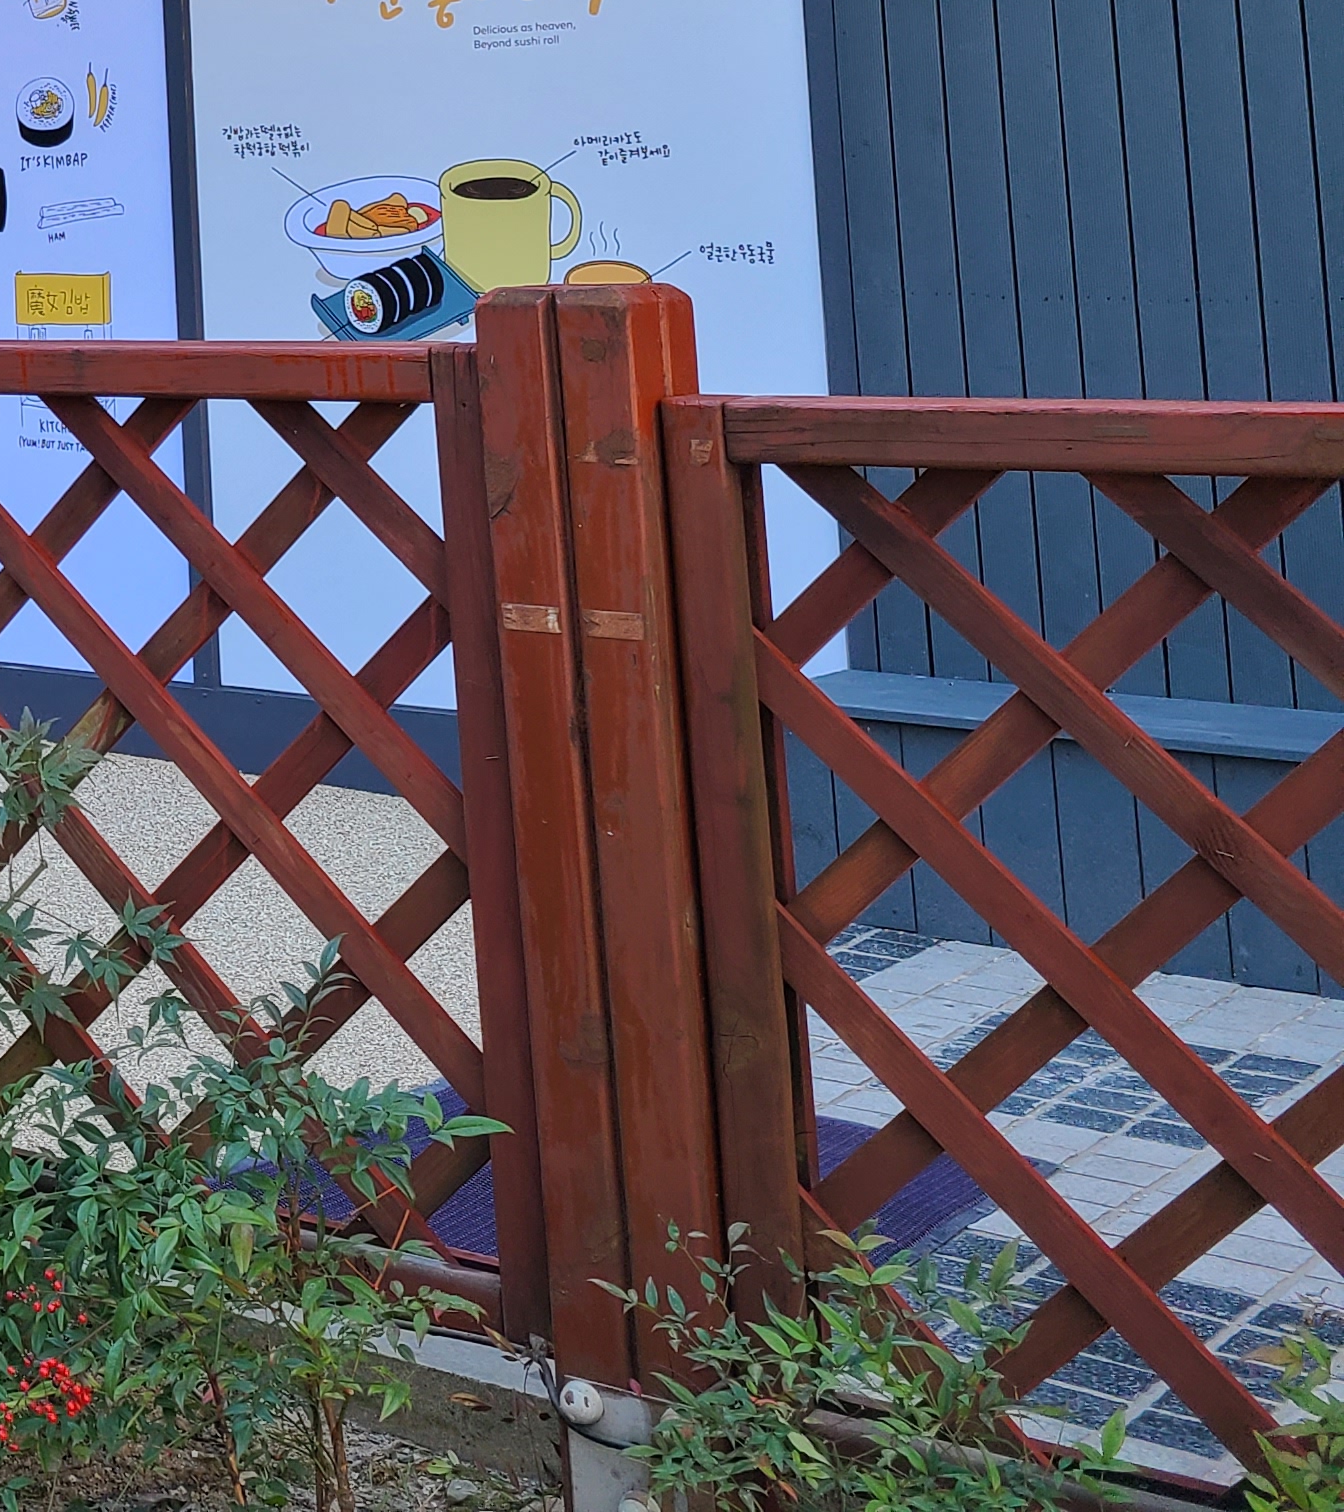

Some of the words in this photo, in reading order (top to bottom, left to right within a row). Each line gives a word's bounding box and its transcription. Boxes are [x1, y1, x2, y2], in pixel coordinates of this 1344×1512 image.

[473, 25, 518, 35] Delicious
[535, 21, 576, 32] heaven,
[474, 38, 512, 50] Beyond
[514, 36, 541, 47] sushi
[543, 35, 560, 45] roll
[573, 131, 642, 147] 아메리카노도
[48, 231, 66, 244] HAM
[39, 418, 67, 434] KITCH
[57, 440, 74, 451] JUST
